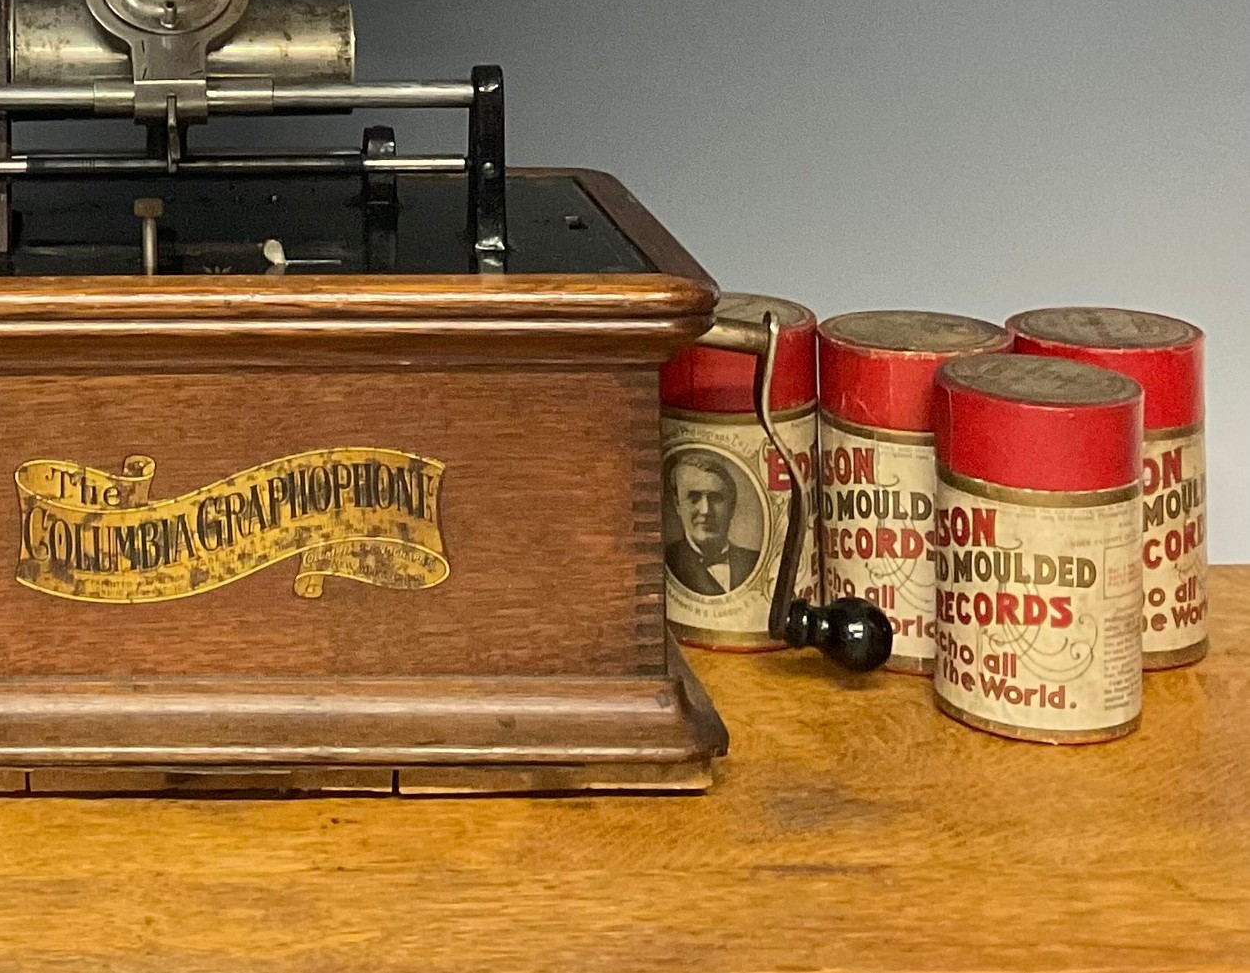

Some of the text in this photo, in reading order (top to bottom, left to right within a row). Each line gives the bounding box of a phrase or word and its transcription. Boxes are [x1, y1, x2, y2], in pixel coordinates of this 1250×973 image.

[44, 465, 121, 507] The
[23, 505, 197, 573] COLUMBIA
[953, 549, 1098, 589] MOULDED
[983, 651, 1018, 679] all
[979, 671, 1078, 711] World.
